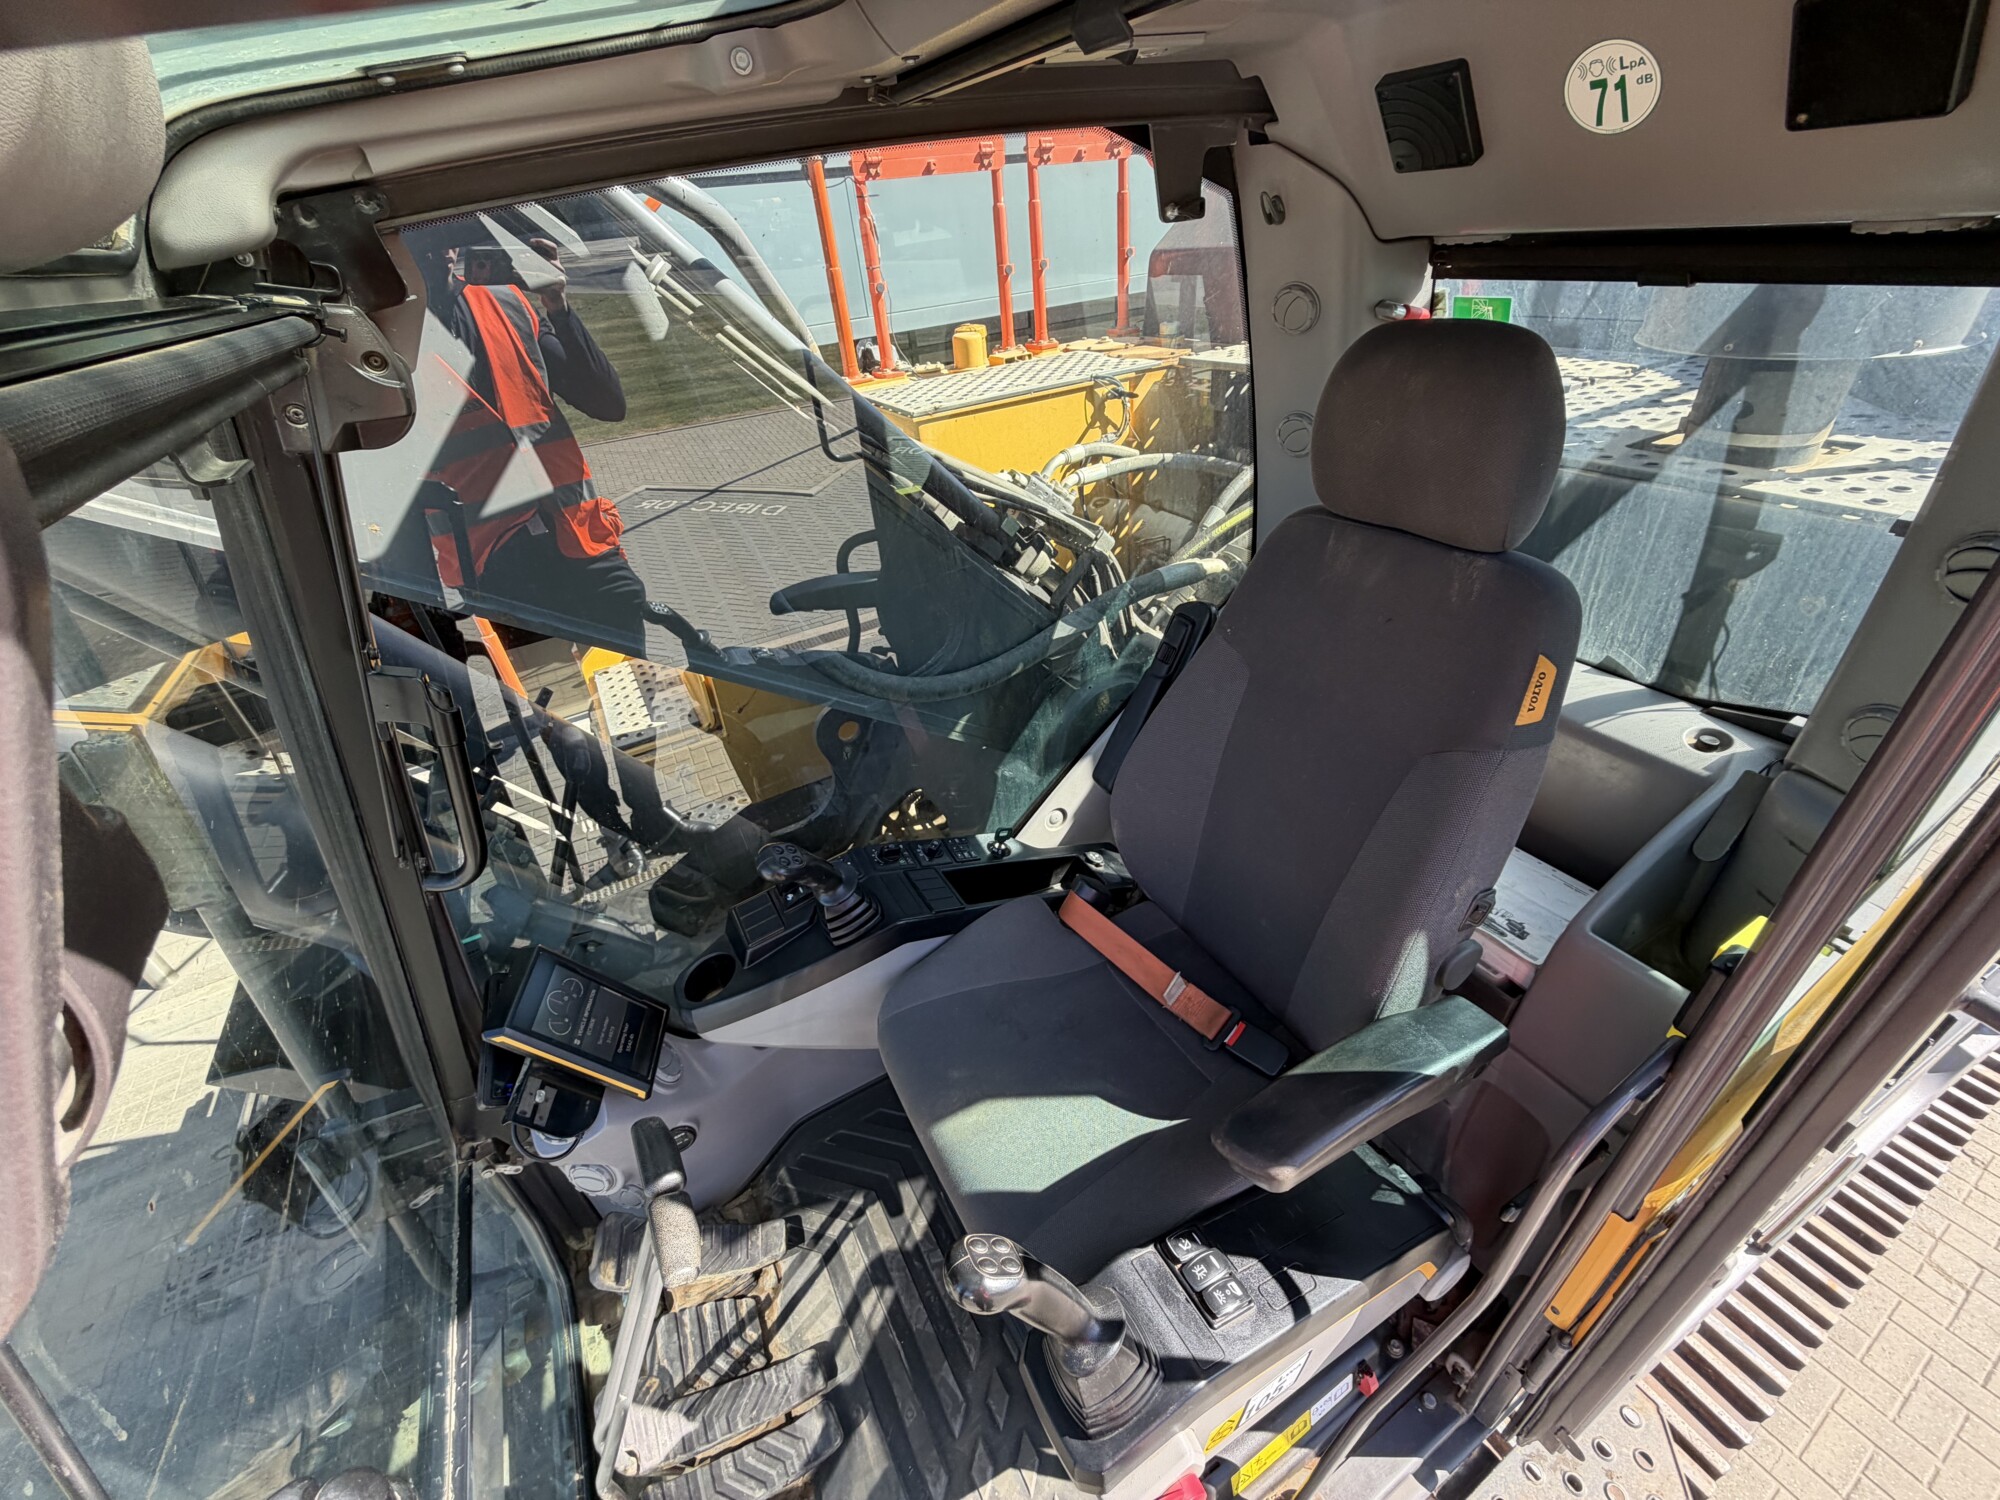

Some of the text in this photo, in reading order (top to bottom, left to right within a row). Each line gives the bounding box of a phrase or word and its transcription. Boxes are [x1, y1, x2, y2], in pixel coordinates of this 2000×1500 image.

[1636, 73, 1654, 85] dB
[1589, 74, 1629, 127] 71
[1527, 671, 1547, 713] VOLVO
[1246, 1380, 1287, 1419] 105
